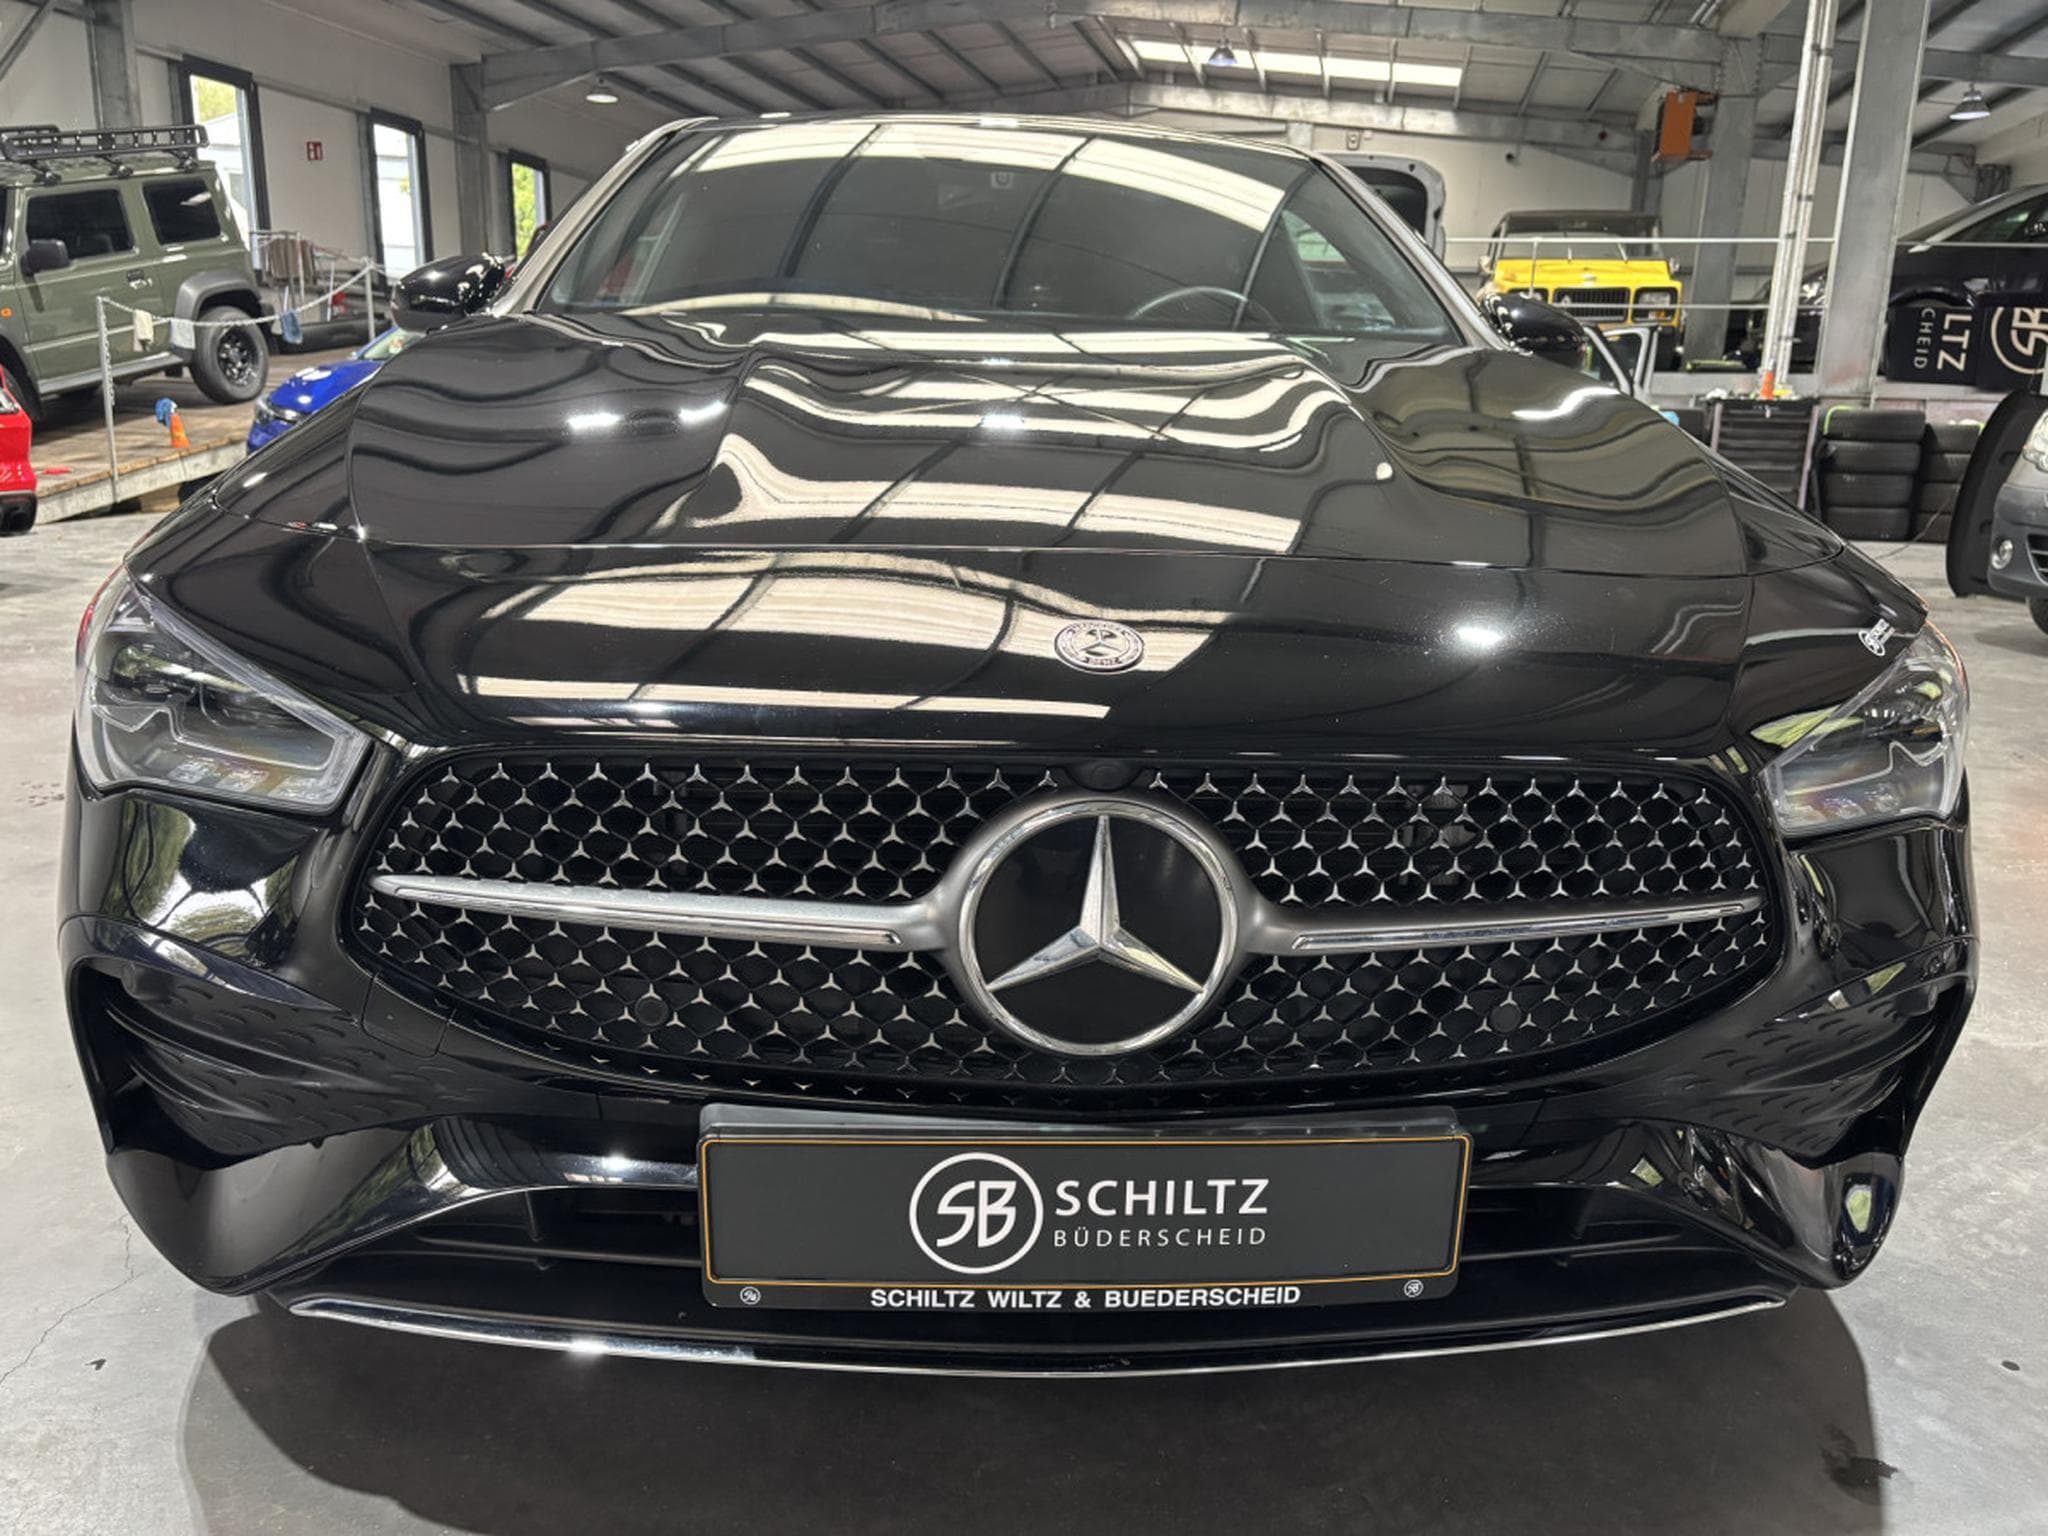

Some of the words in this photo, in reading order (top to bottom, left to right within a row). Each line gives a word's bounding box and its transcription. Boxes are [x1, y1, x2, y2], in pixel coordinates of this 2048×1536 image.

[1055, 1178, 1270, 1217] SCHILTZ
[936, 1180, 1017, 1249] SB
[1053, 1226, 1267, 1248] BÜDERSCHEID
[870, 1289, 975, 1309] SCHILTZ
[987, 1290, 1063, 1309] WILTZ
[1074, 1290, 1091, 1309] &
[1104, 1286, 1301, 1309] BUEDERSCHEID
